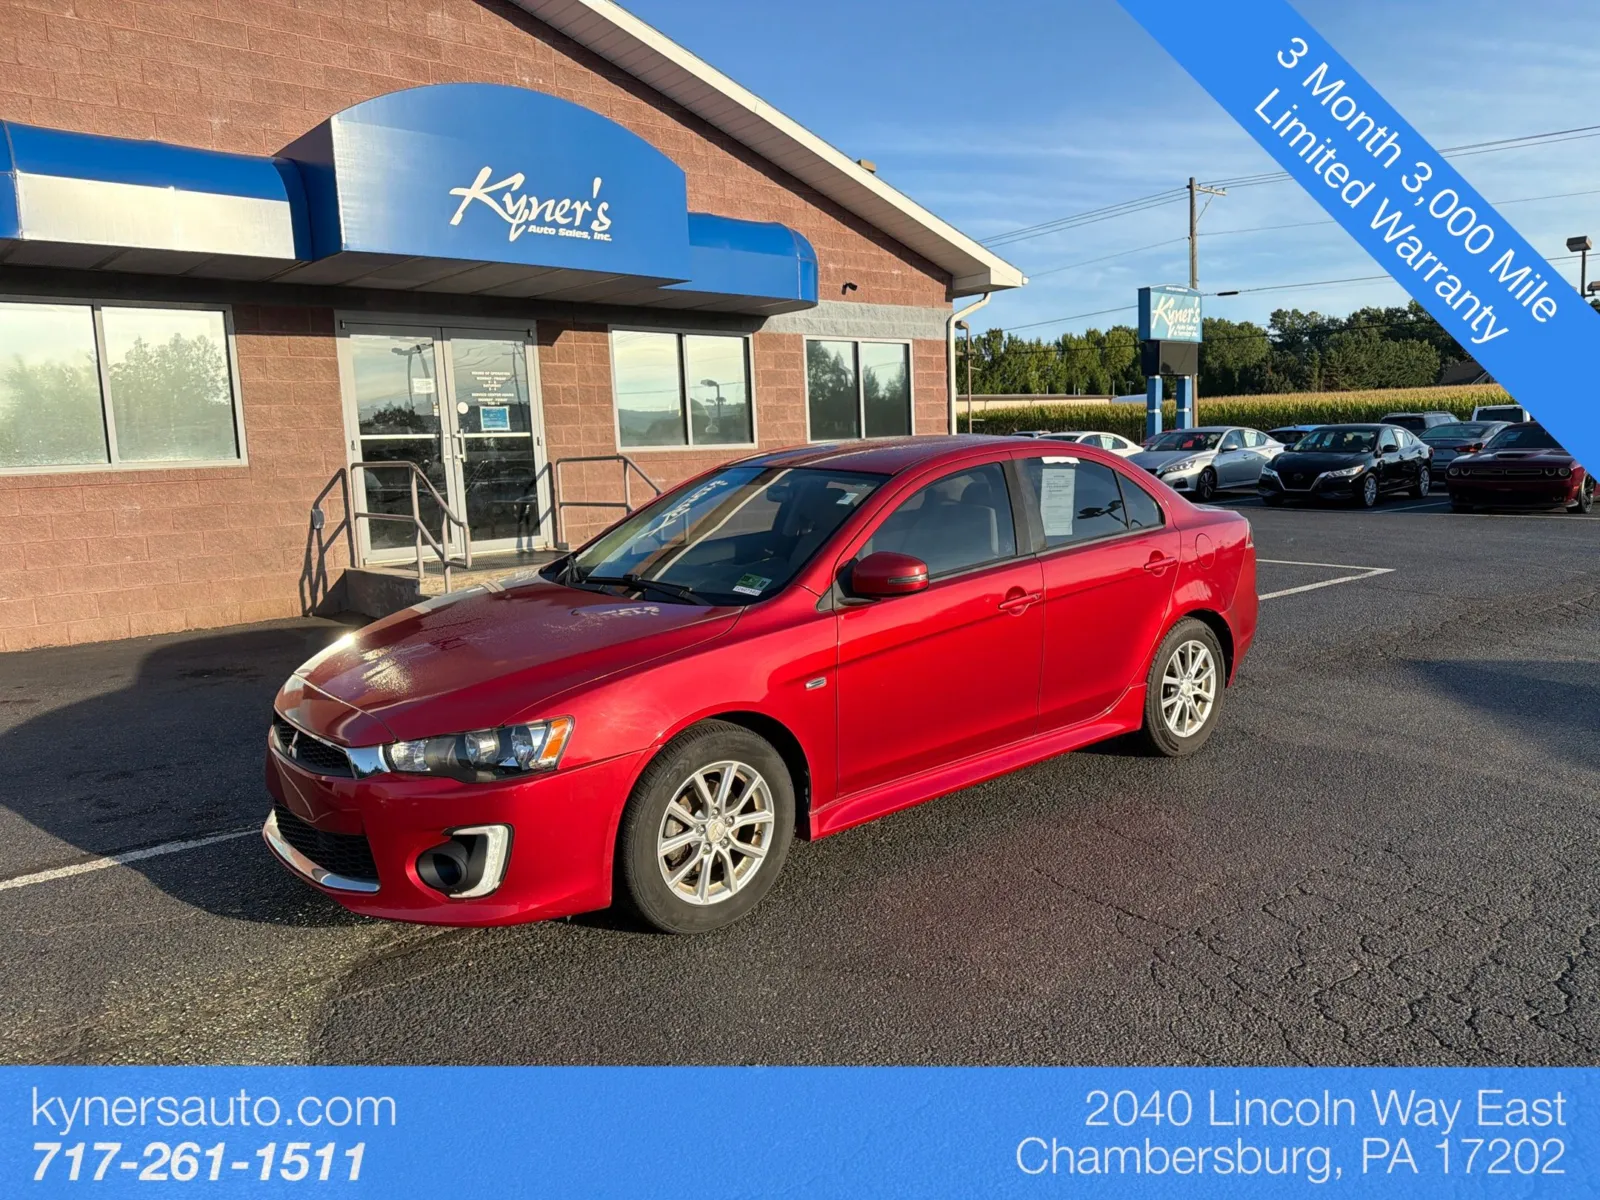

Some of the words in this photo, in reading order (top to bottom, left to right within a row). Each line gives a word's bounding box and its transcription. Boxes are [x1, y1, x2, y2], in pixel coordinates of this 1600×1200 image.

[449, 166, 612, 242] Kyner's
[527, 224, 556, 235] Auto
[558, 227, 591, 240] Sales,
[593, 232, 613, 242] Inc.
